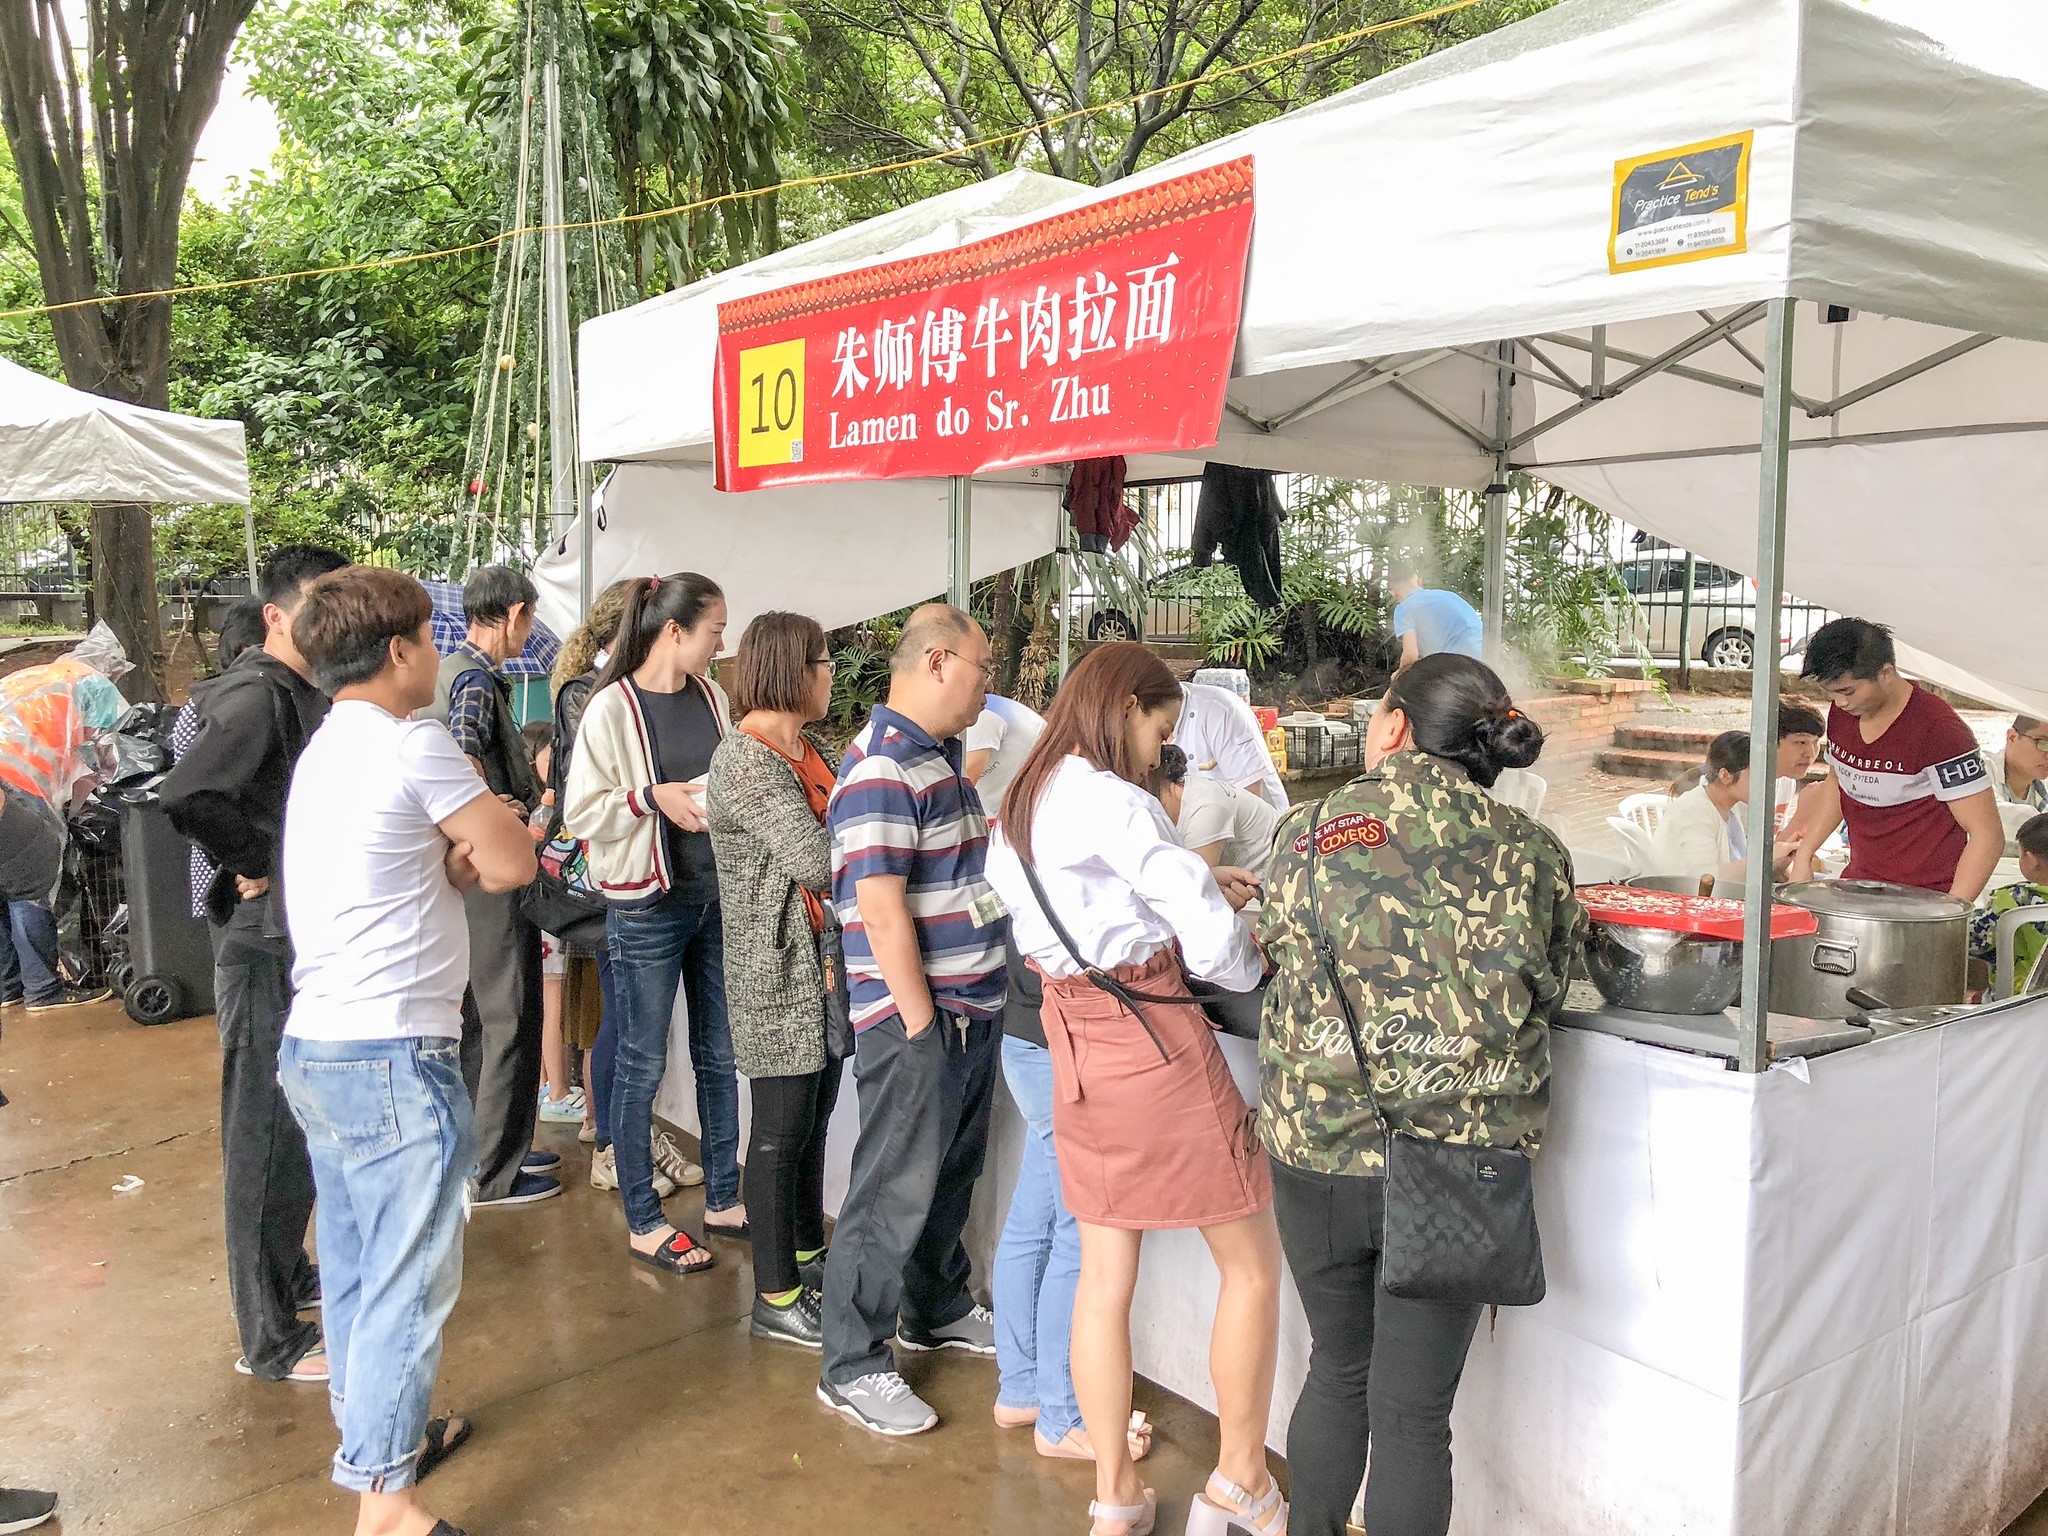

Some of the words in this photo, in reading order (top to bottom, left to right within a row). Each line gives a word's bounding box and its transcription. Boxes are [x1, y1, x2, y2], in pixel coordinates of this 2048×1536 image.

[1634, 194, 1681, 212] Practice
[1685, 184, 1719, 202] Tend's
[830, 250, 1180, 398] 朱师傅牛肉拉面
[750, 368, 797, 435] 10
[828, 411, 919, 449] Lamen
[936, 396, 970, 437] do
[985, 389, 1030, 432] Sr.
[1049, 374, 1111, 423] Zhu
[1030, 467, 1039, 478] 35
[1321, 822, 1380, 851] COVERS
[1323, 821, 1336, 834] MY
[1337, 815, 1364, 828] STAR
[1370, 1014, 1468, 1056] Covers
